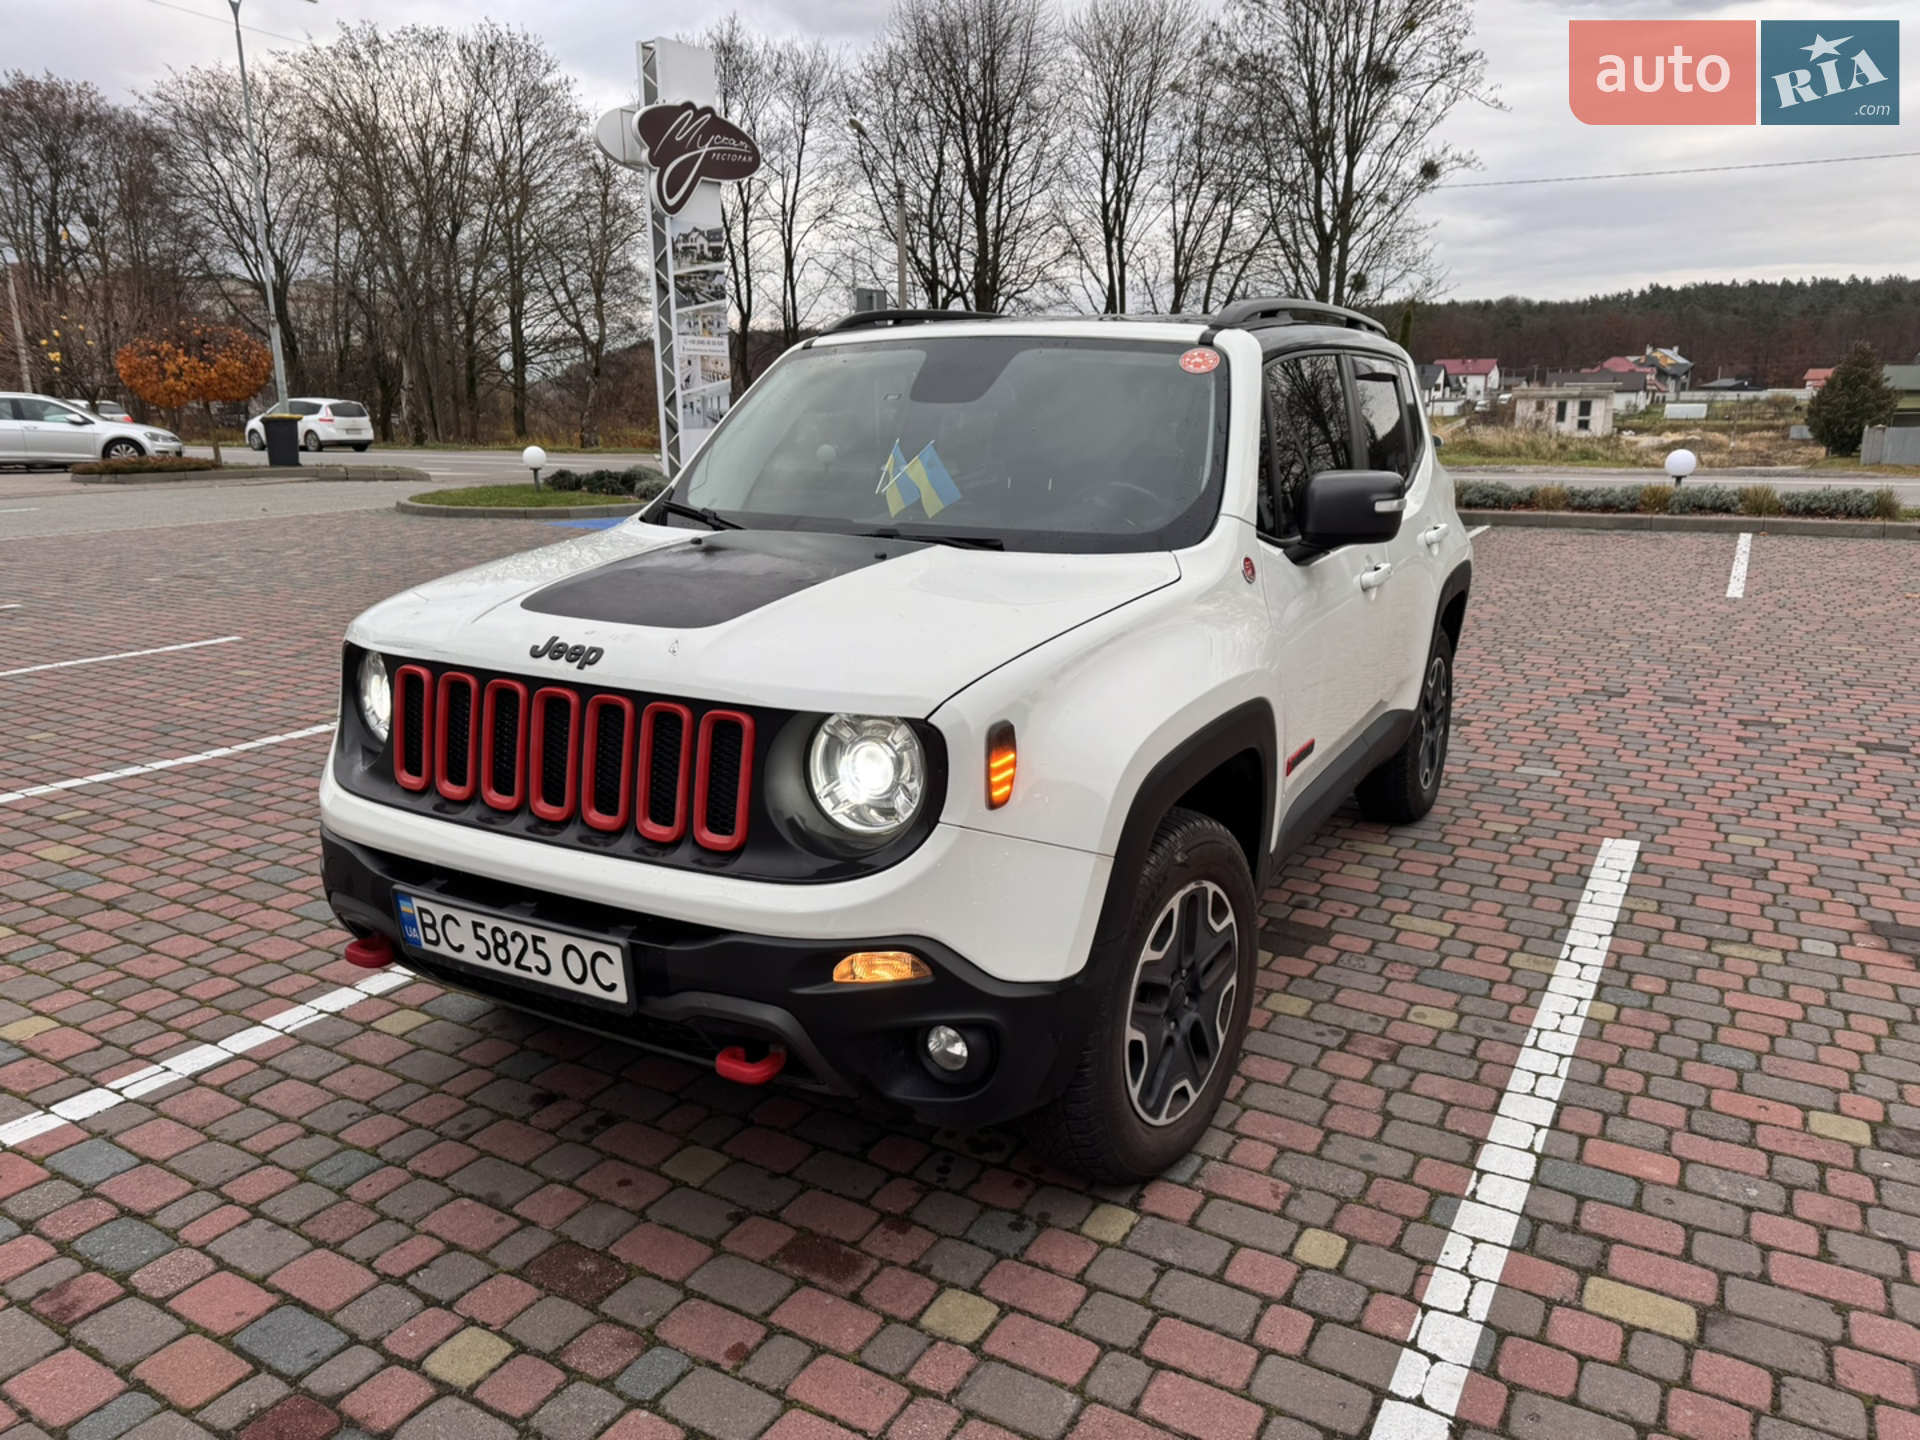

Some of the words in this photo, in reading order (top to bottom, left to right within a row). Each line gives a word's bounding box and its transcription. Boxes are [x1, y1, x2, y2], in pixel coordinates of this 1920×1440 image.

[711, 151, 754, 163] РЕСТОРАН
[529, 635, 605, 670] Jeep
[404, 924, 420, 940] UA
[416, 905, 465, 954] BC
[471, 919, 552, 977] 5825
[561, 943, 618, 993] OC
